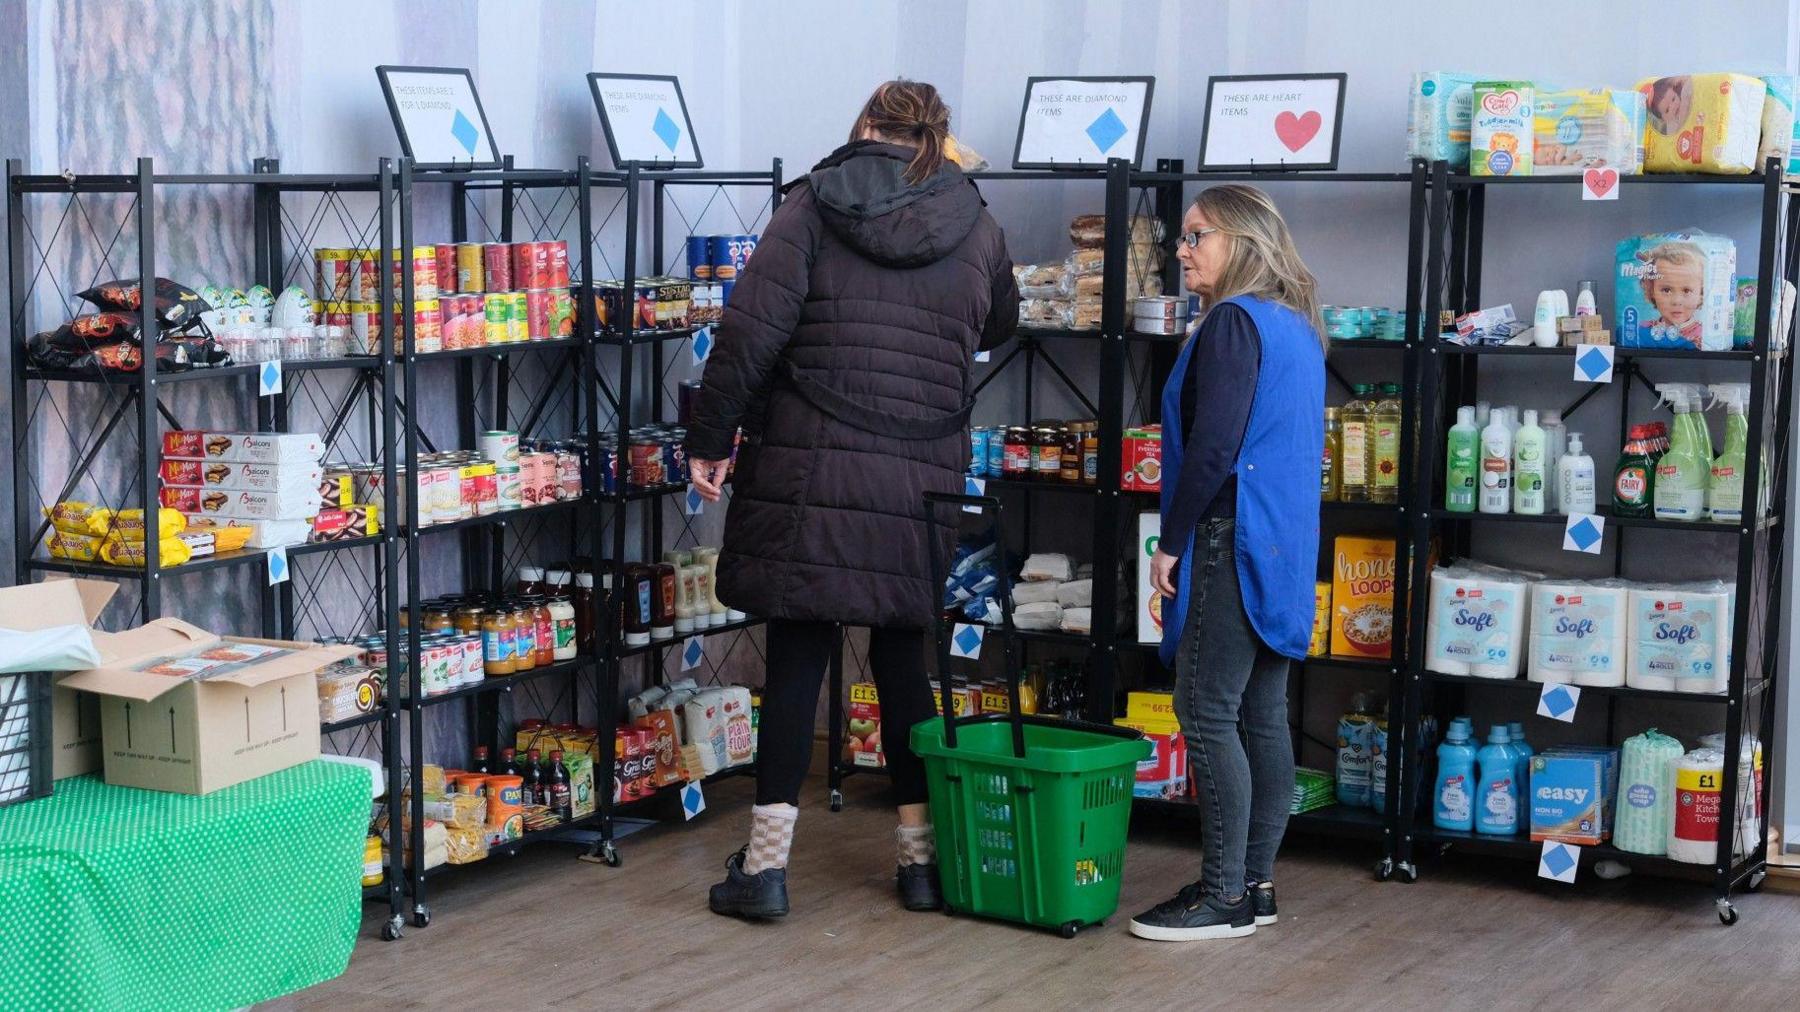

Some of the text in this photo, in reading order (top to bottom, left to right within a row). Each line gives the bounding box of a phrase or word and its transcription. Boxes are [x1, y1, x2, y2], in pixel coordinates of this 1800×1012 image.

[1040, 94, 1127, 104] THESE ARE DIAMOND
[1223, 93, 1303, 103] THESE ARE HEART
[1037, 108, 1062, 116] ITEMS
[1221, 108, 1248, 116] ITEMS
[1627, 310, 1635, 322] 5
[1621, 479, 1640, 490] FAIRY
[1455, 608, 1494, 632] Soft
[1556, 616, 1594, 639] Soft
[1656, 622, 1697, 645] Soft
[1699, 775, 1715, 788] £1
[1537, 786, 1589, 804] easy
[1696, 795, 1721, 805] Mega
